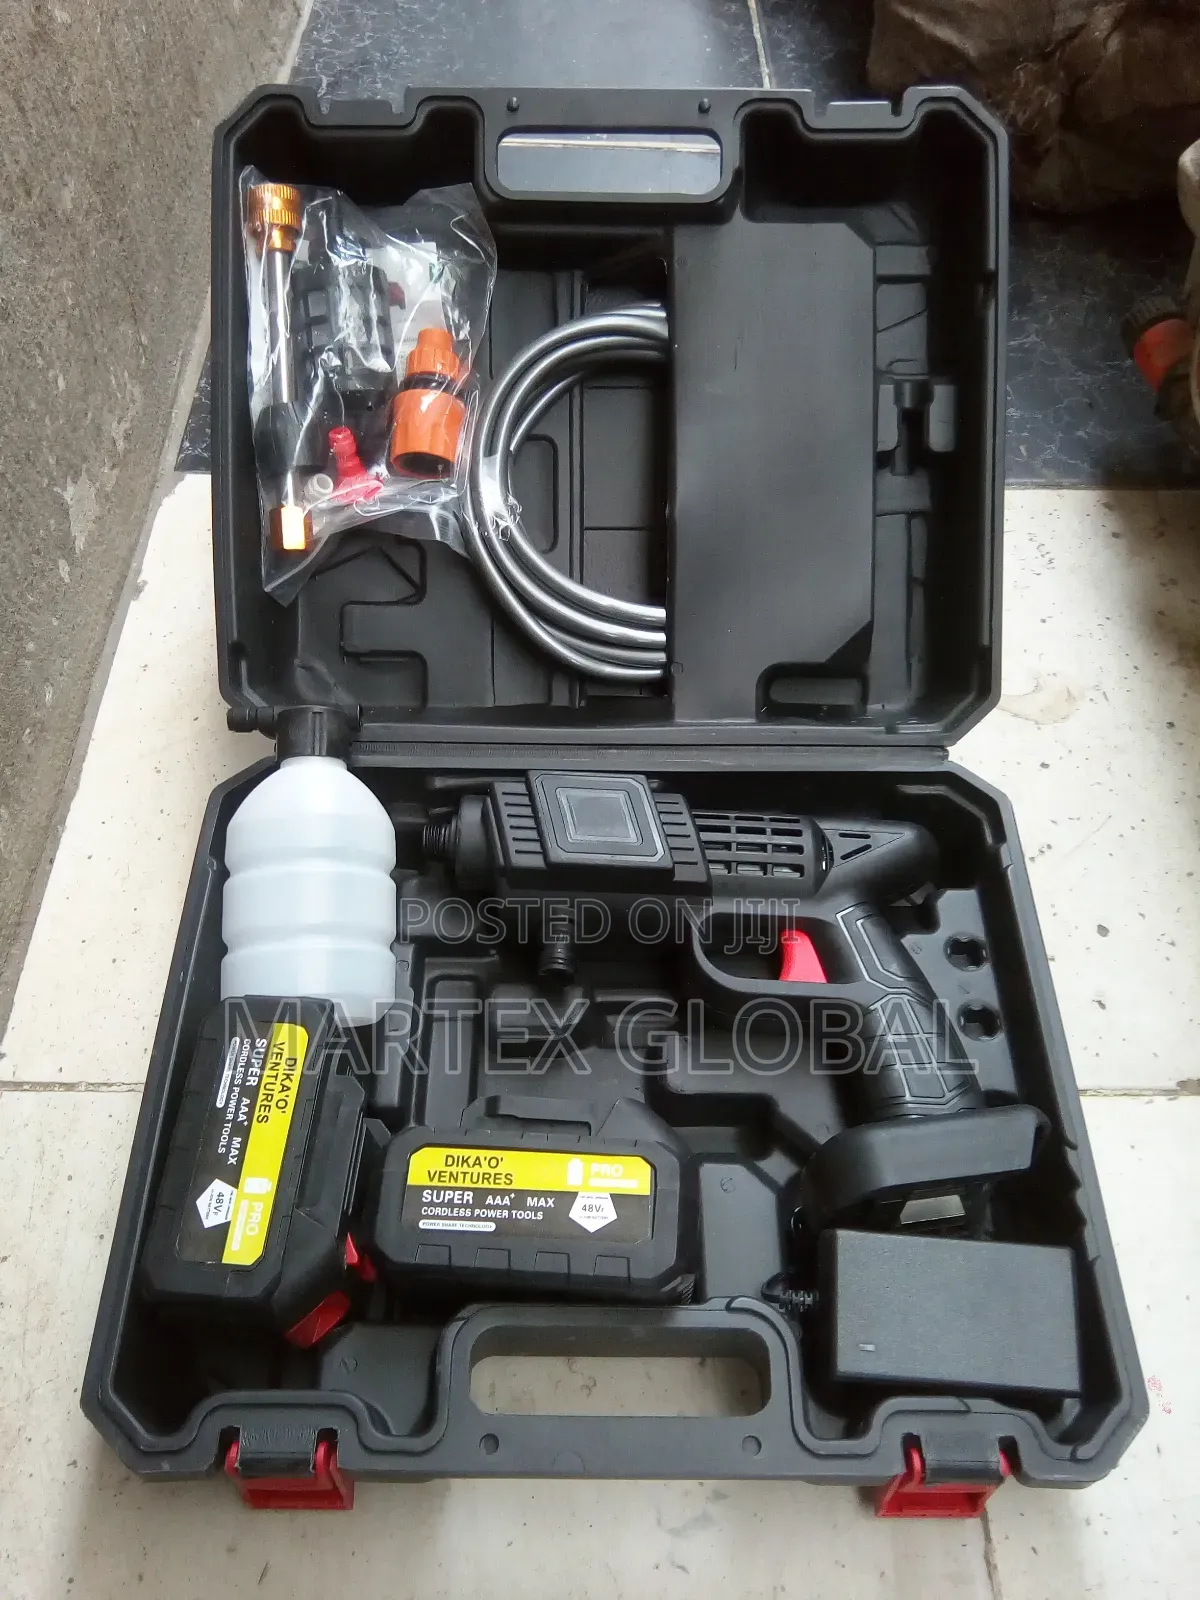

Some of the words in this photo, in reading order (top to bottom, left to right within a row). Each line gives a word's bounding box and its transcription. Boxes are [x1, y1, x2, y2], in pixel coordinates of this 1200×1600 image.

[233, 1038, 251, 1085] CORDLESS
[245, 1038, 268, 1087] SUPER
[256, 1041, 287, 1124] VENTURES
[275, 1057, 298, 1114] DIKA'O'
[225, 1086, 240, 1120] POWER
[217, 1121, 232, 1154] TOOLS
[227, 1136, 242, 1165] MAX
[427, 1169, 514, 1186] VENTURES
[444, 1154, 504, 1169] DIKA'O'
[590, 1162, 624, 1178] PRO
[421, 1189, 474, 1205] SUPER
[526, 1196, 556, 1208] MAX
[421, 1206, 472, 1217] CORDLESS
[474, 1208, 509, 1219] POWER
[511, 1210, 544, 1220] TOOLS
[245, 1201, 264, 1236] PRO
